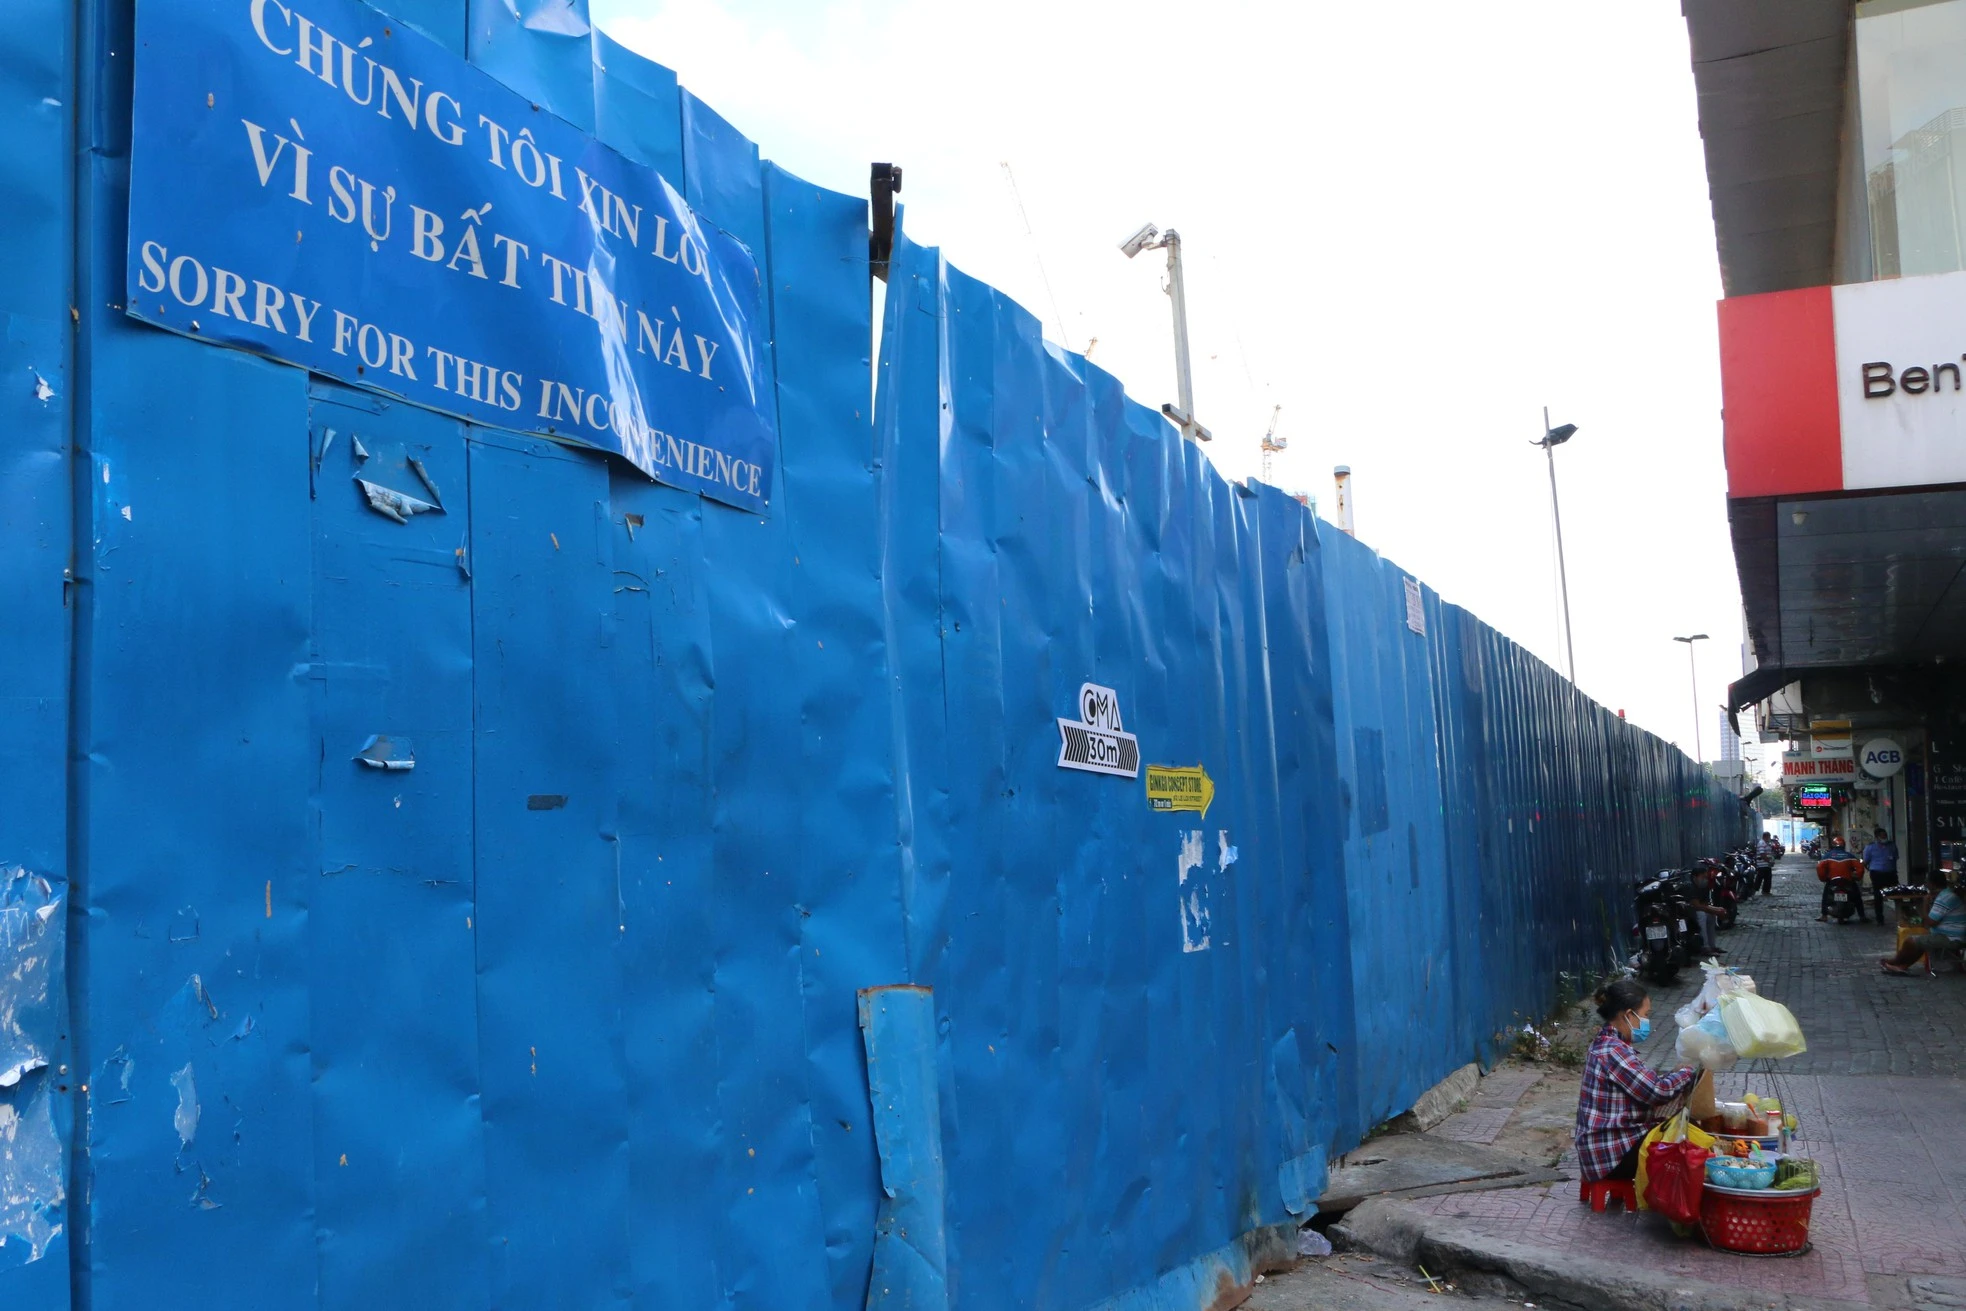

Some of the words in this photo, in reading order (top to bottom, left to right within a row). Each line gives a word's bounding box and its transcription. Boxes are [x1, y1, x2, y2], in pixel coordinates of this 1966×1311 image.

[249, 0, 467, 147] CHÚNG
[479, 114, 567, 200] TÔI
[574, 166, 643, 248] XIN
[242, 117, 313, 206] VÌ
[328, 165, 396, 252] SỰ
[410, 202, 529, 289] BẤT
[541, 254, 628, 344] TIN
[636, 306, 720, 381] NÀY
[138, 240, 322, 344] SORRY
[332, 309, 418, 382] FOR
[426, 347, 523, 412] THIS
[538, 378, 763, 498] INCOENIENCE
[1861, 353, 1966, 399] Ben
[1089, 736, 1118, 763] 30m
[1784, 760, 1815, 777] MẠNH
[1865, 750, 1901, 764] ACB
